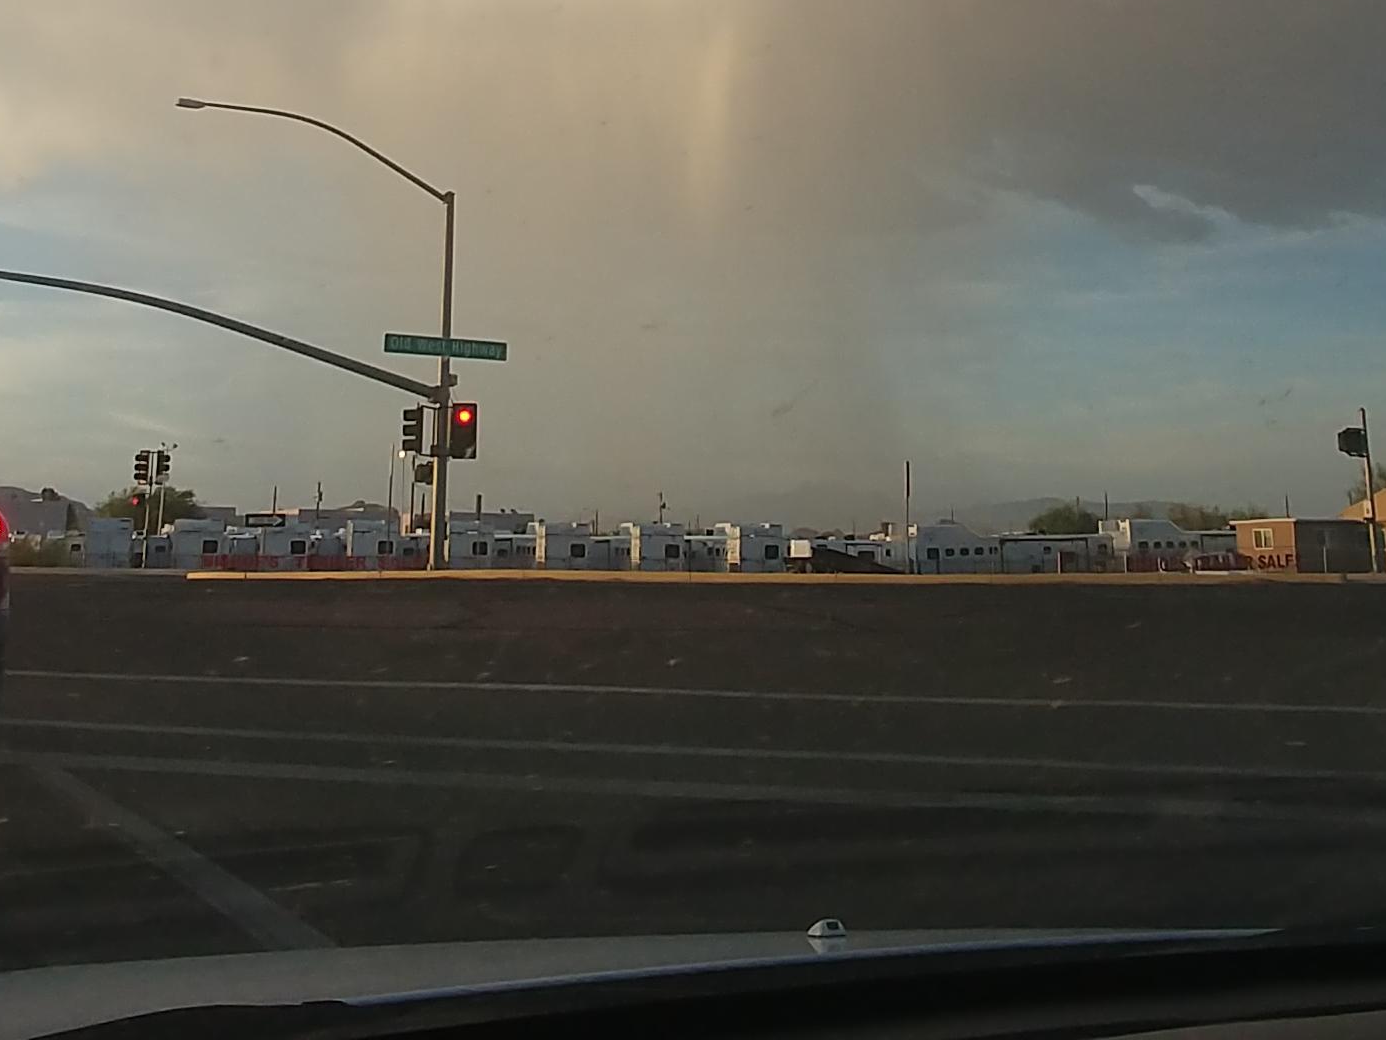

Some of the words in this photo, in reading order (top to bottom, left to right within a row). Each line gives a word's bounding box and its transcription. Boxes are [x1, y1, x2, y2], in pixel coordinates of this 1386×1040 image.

[390, 336, 412, 350] Old
[417, 339, 447, 354] West
[453, 341, 503, 359] Highway
